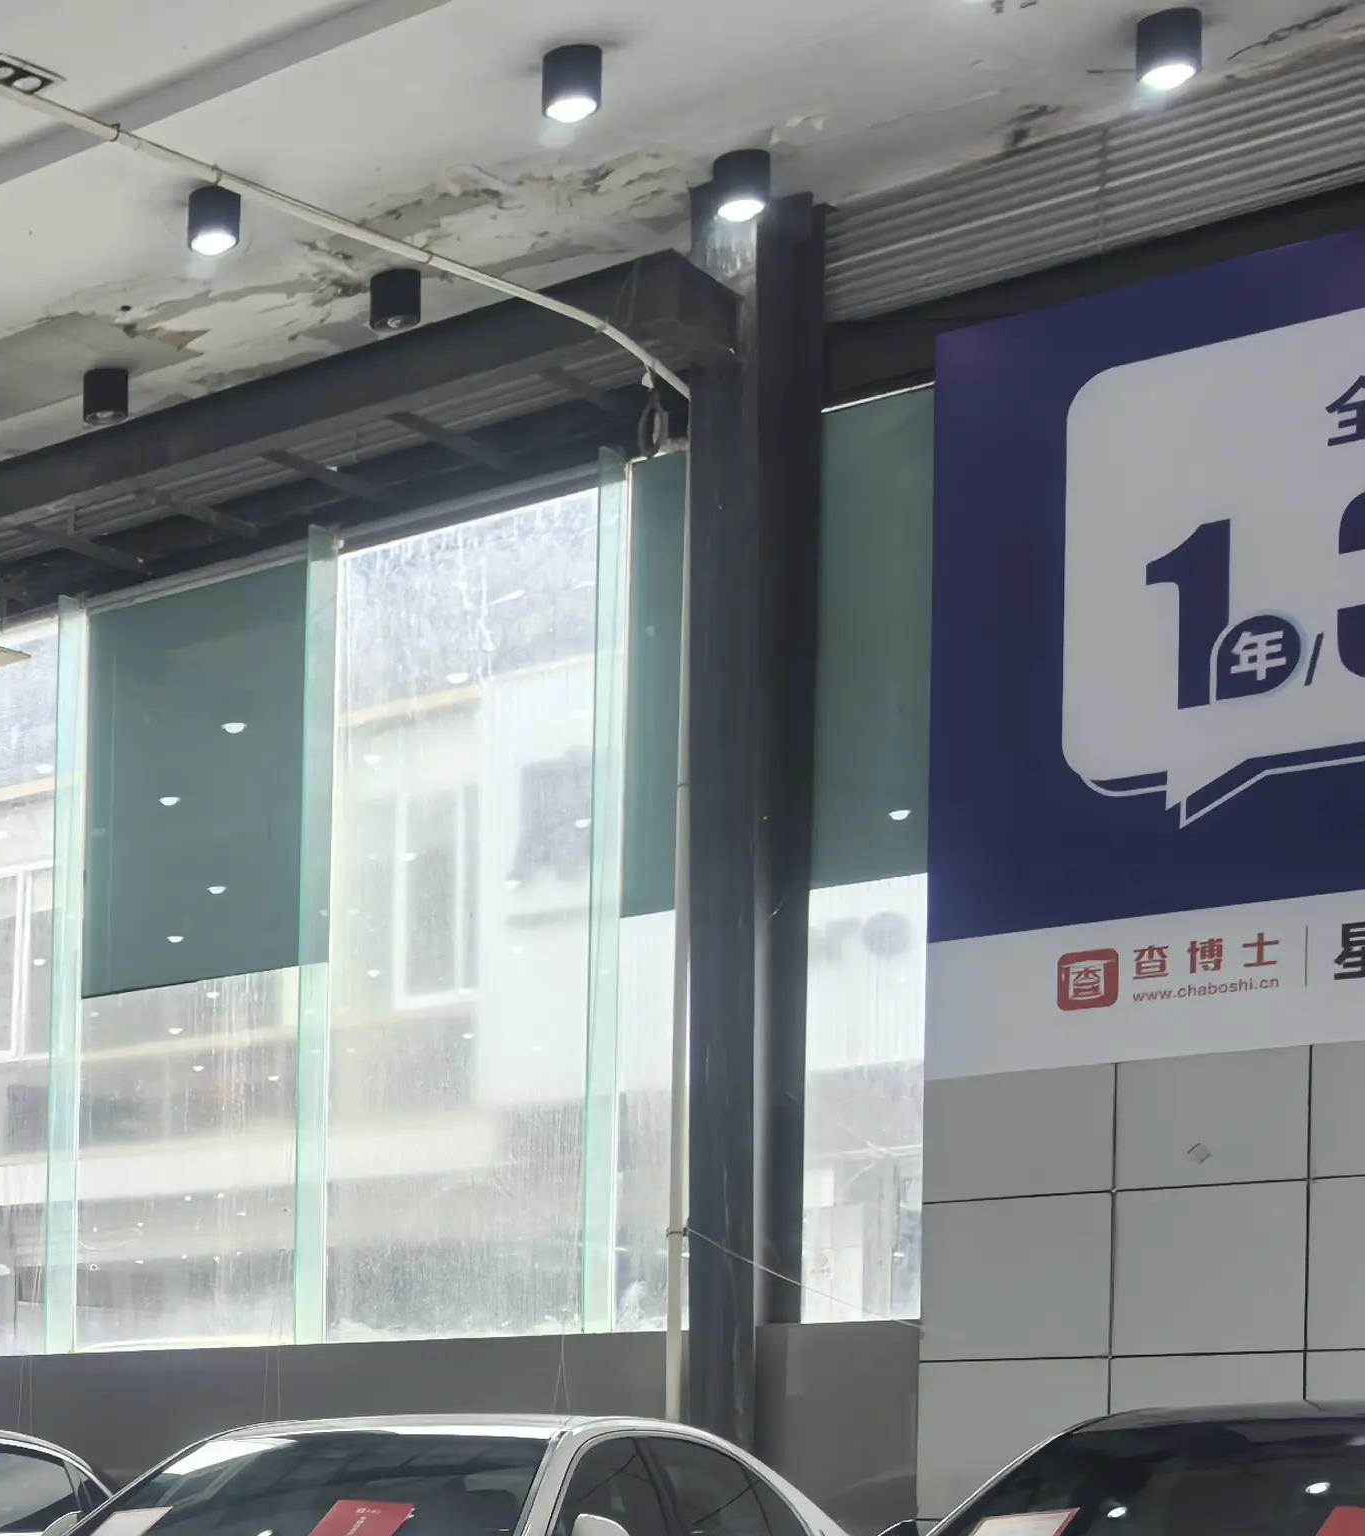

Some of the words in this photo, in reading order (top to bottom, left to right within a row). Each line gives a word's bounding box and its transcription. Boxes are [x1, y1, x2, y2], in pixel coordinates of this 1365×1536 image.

[1133, 932, 1280, 980] 查博士
[1132, 977, 1280, 1002] www.chaboshi.cn
